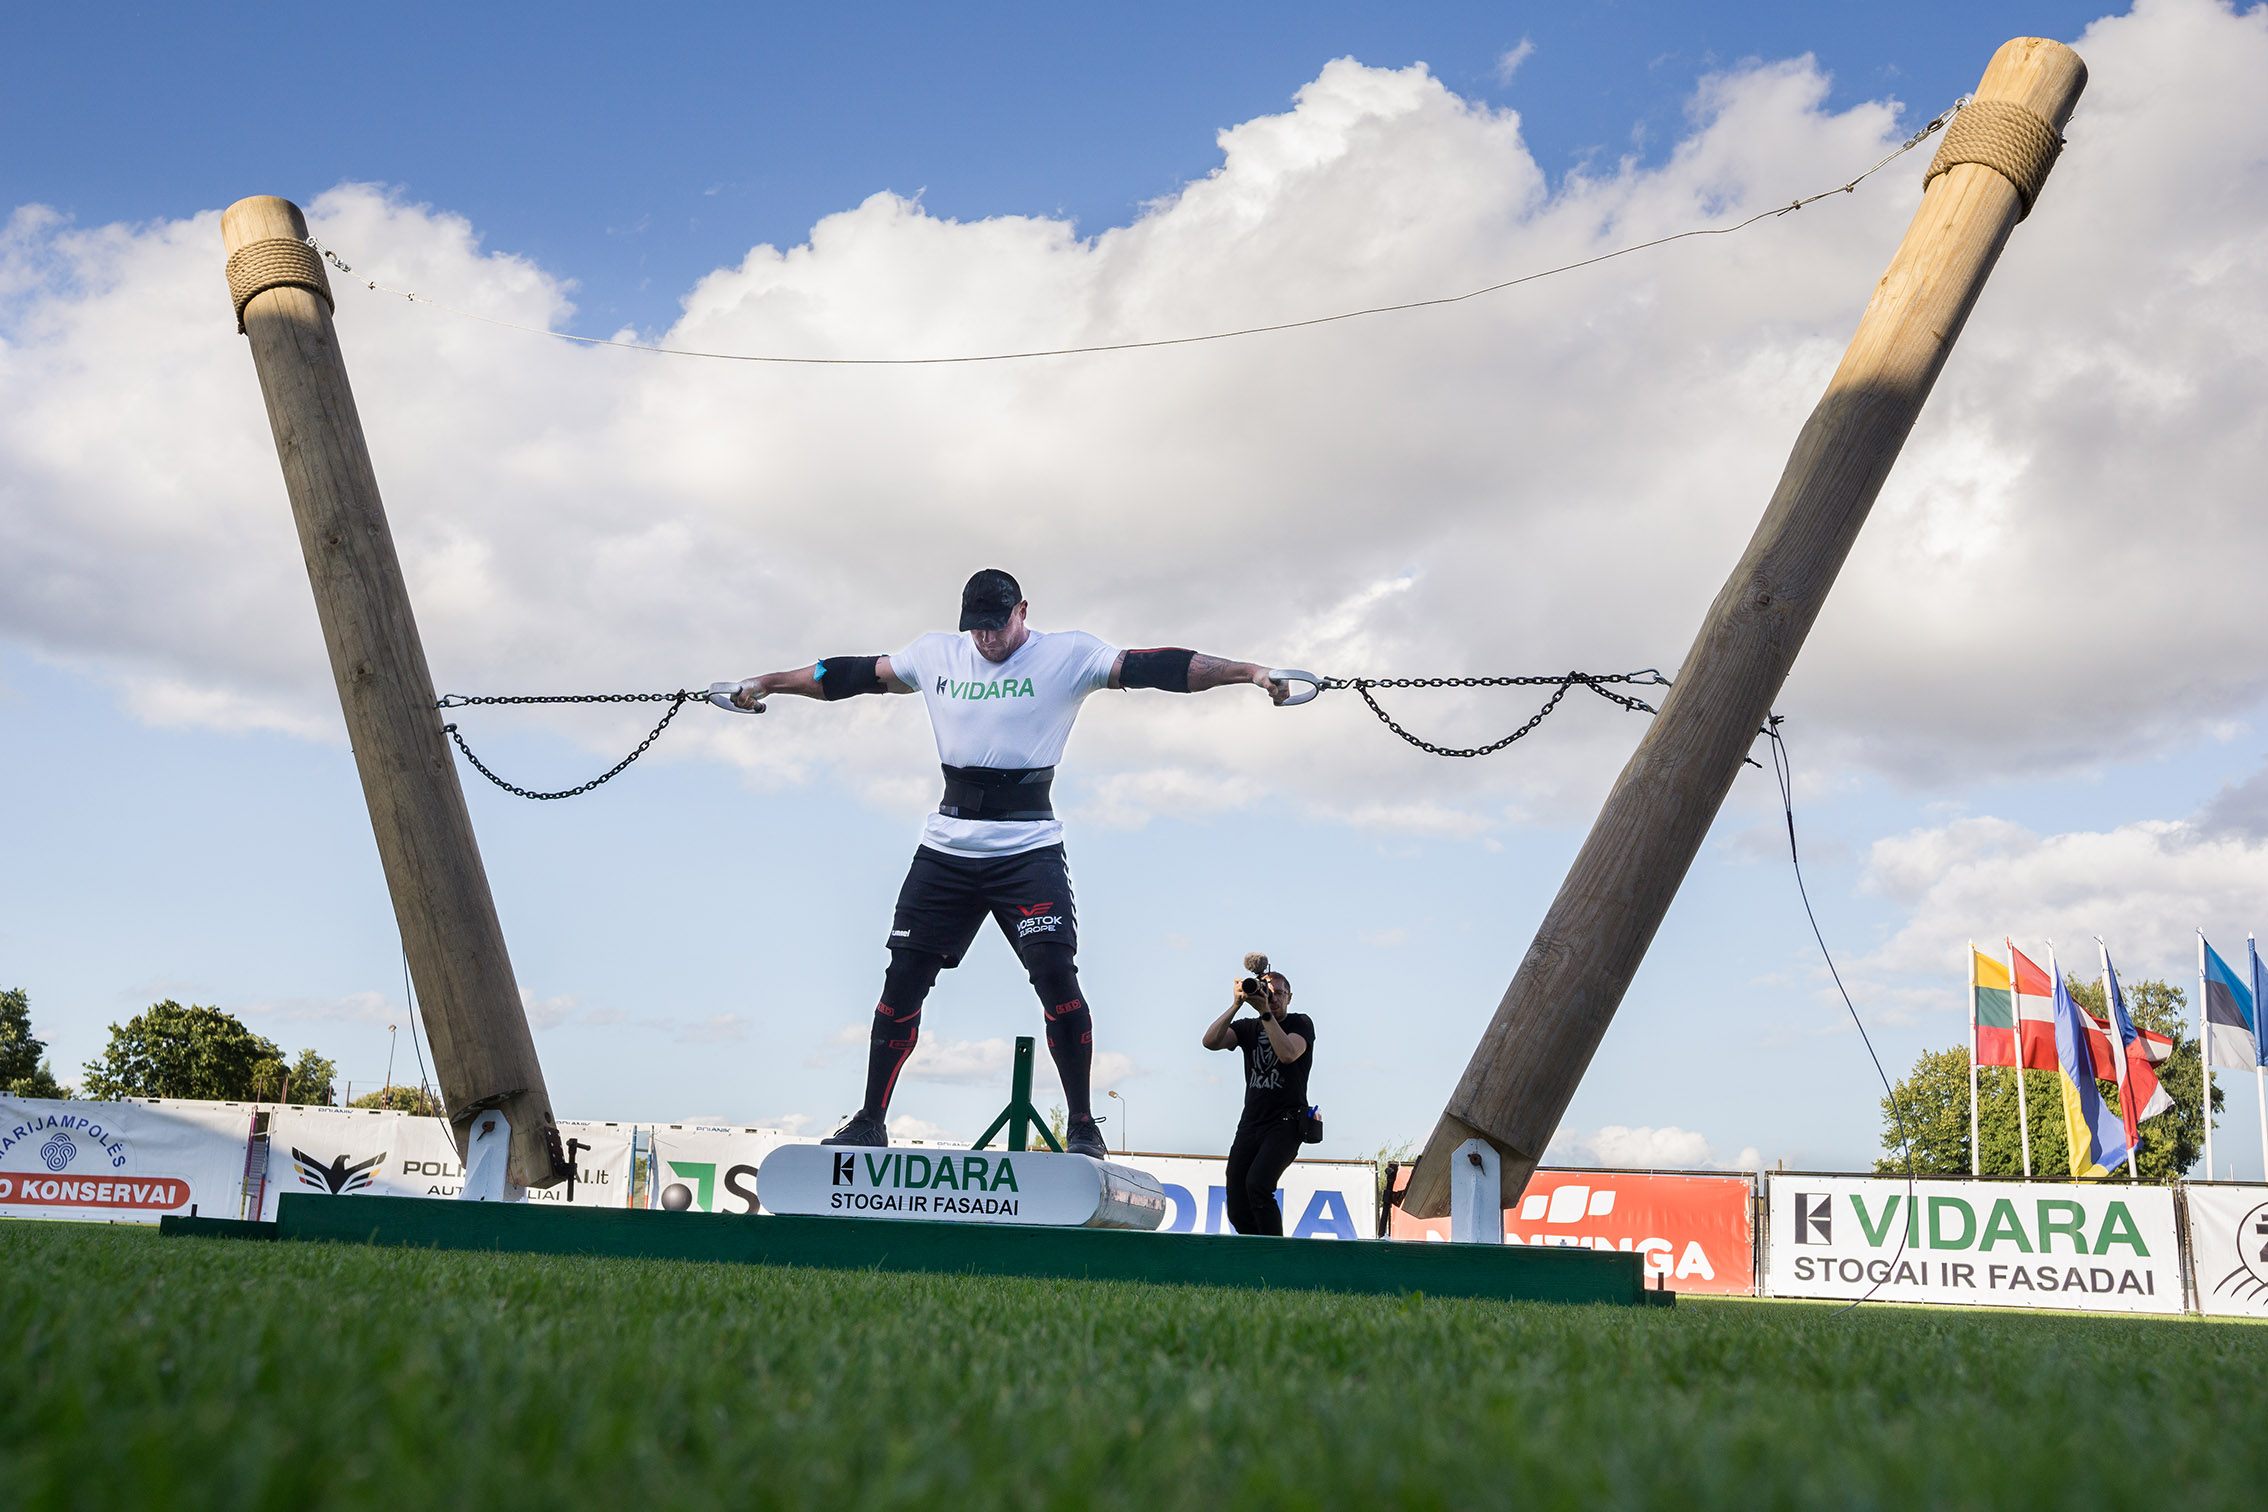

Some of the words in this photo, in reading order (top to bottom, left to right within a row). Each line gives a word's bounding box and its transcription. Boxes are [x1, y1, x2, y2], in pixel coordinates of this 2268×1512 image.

[950, 677, 1035, 700] VIDARA
[864, 1153, 1020, 1193] VIDARA
[20, 1180, 176, 1205] KONSERVAI
[830, 1193, 904, 1211] STOGAI
[908, 1195, 928, 1213] IR
[933, 1196, 1019, 1216] FASADAI
[1850, 1194, 2151, 1258] VIDARA
[1794, 1256, 1928, 1287] STOGAI
[1942, 1262, 1975, 1289] IR
[1989, 1264, 2155, 1296] FASADAI
